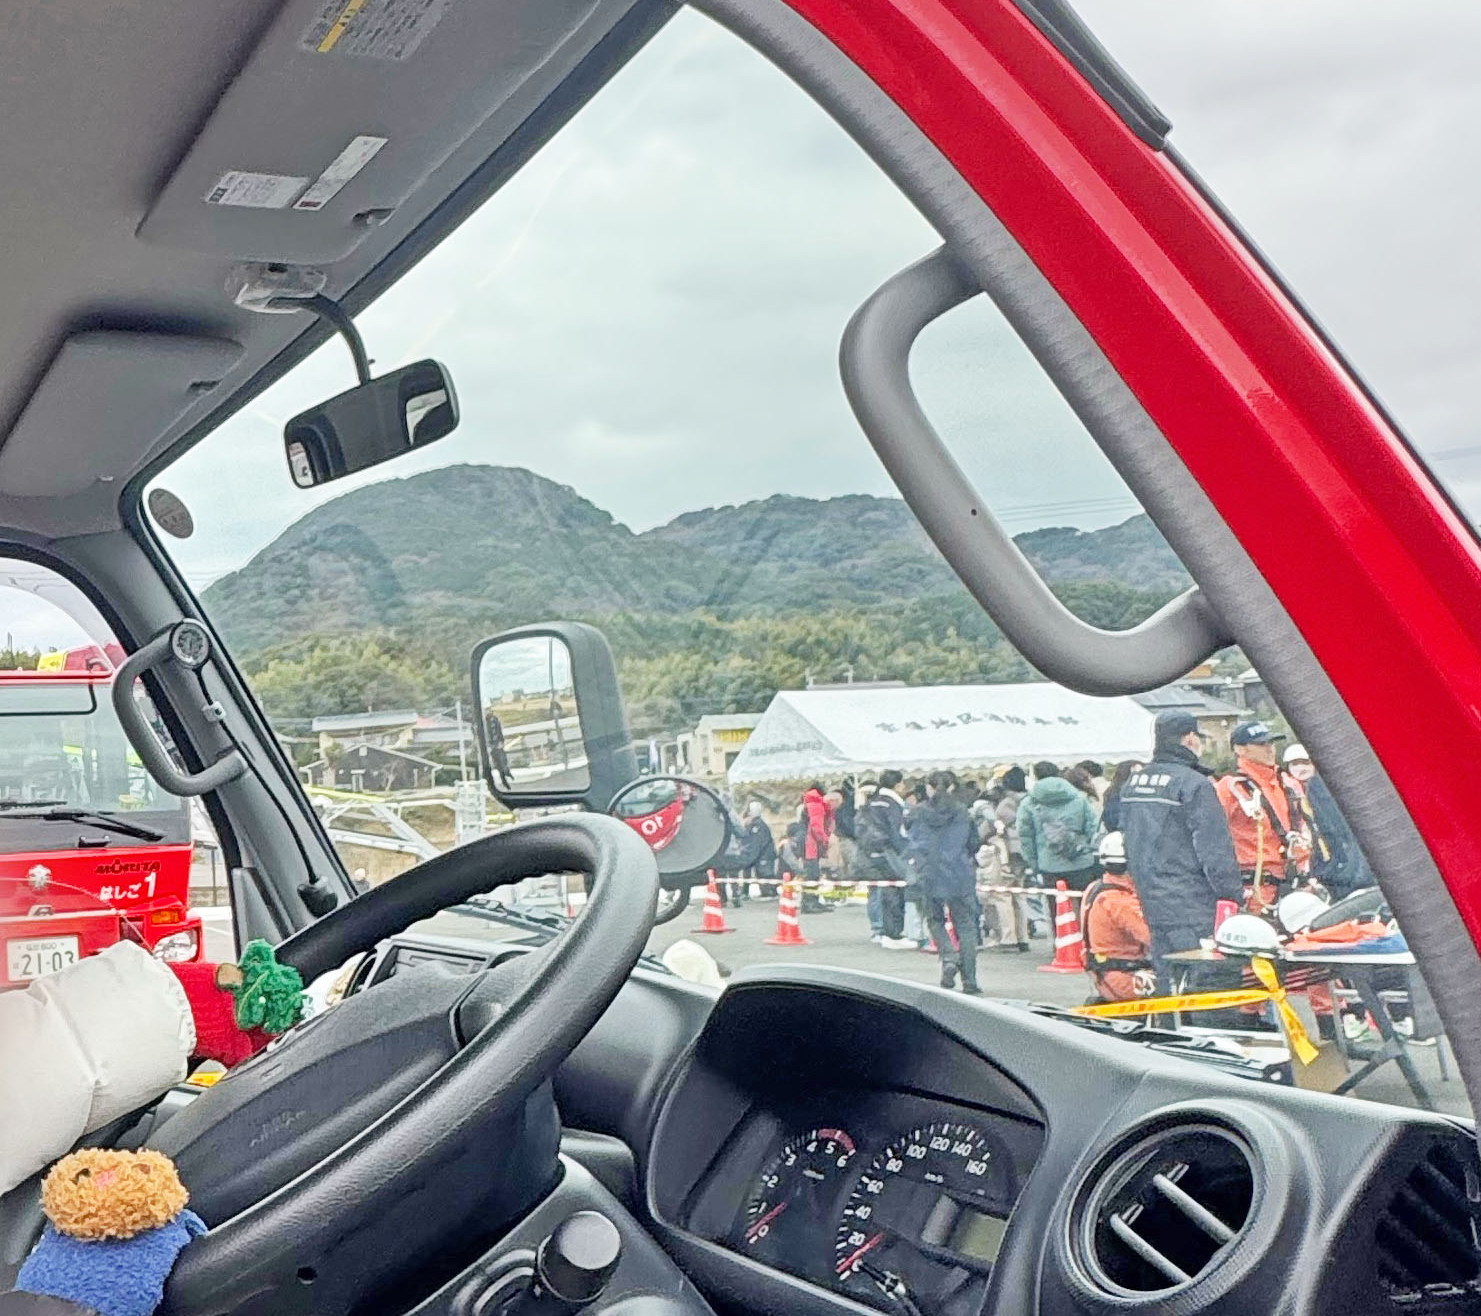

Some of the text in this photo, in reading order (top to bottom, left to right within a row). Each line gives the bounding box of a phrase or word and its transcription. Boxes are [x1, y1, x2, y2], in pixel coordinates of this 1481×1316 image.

[806, 1141, 818, 1153] 4
[824, 1141, 836, 1154] 5
[930, 1136, 950, 1151] 120
[951, 1140, 973, 1157] 140
[785, 1153, 797, 1166] 3
[906, 1144, 927, 1160] 100
[837, 1155, 849, 1167] 6
[886, 1157, 903, 1173] 80
[965, 1158, 988, 1176] 160
[767, 1175, 779, 1188] 2
[867, 1179, 884, 1194] 60
[855, 1205, 872, 1220] 40
[758, 1224, 769, 1237] 0
[848, 1231, 866, 1246] 20
